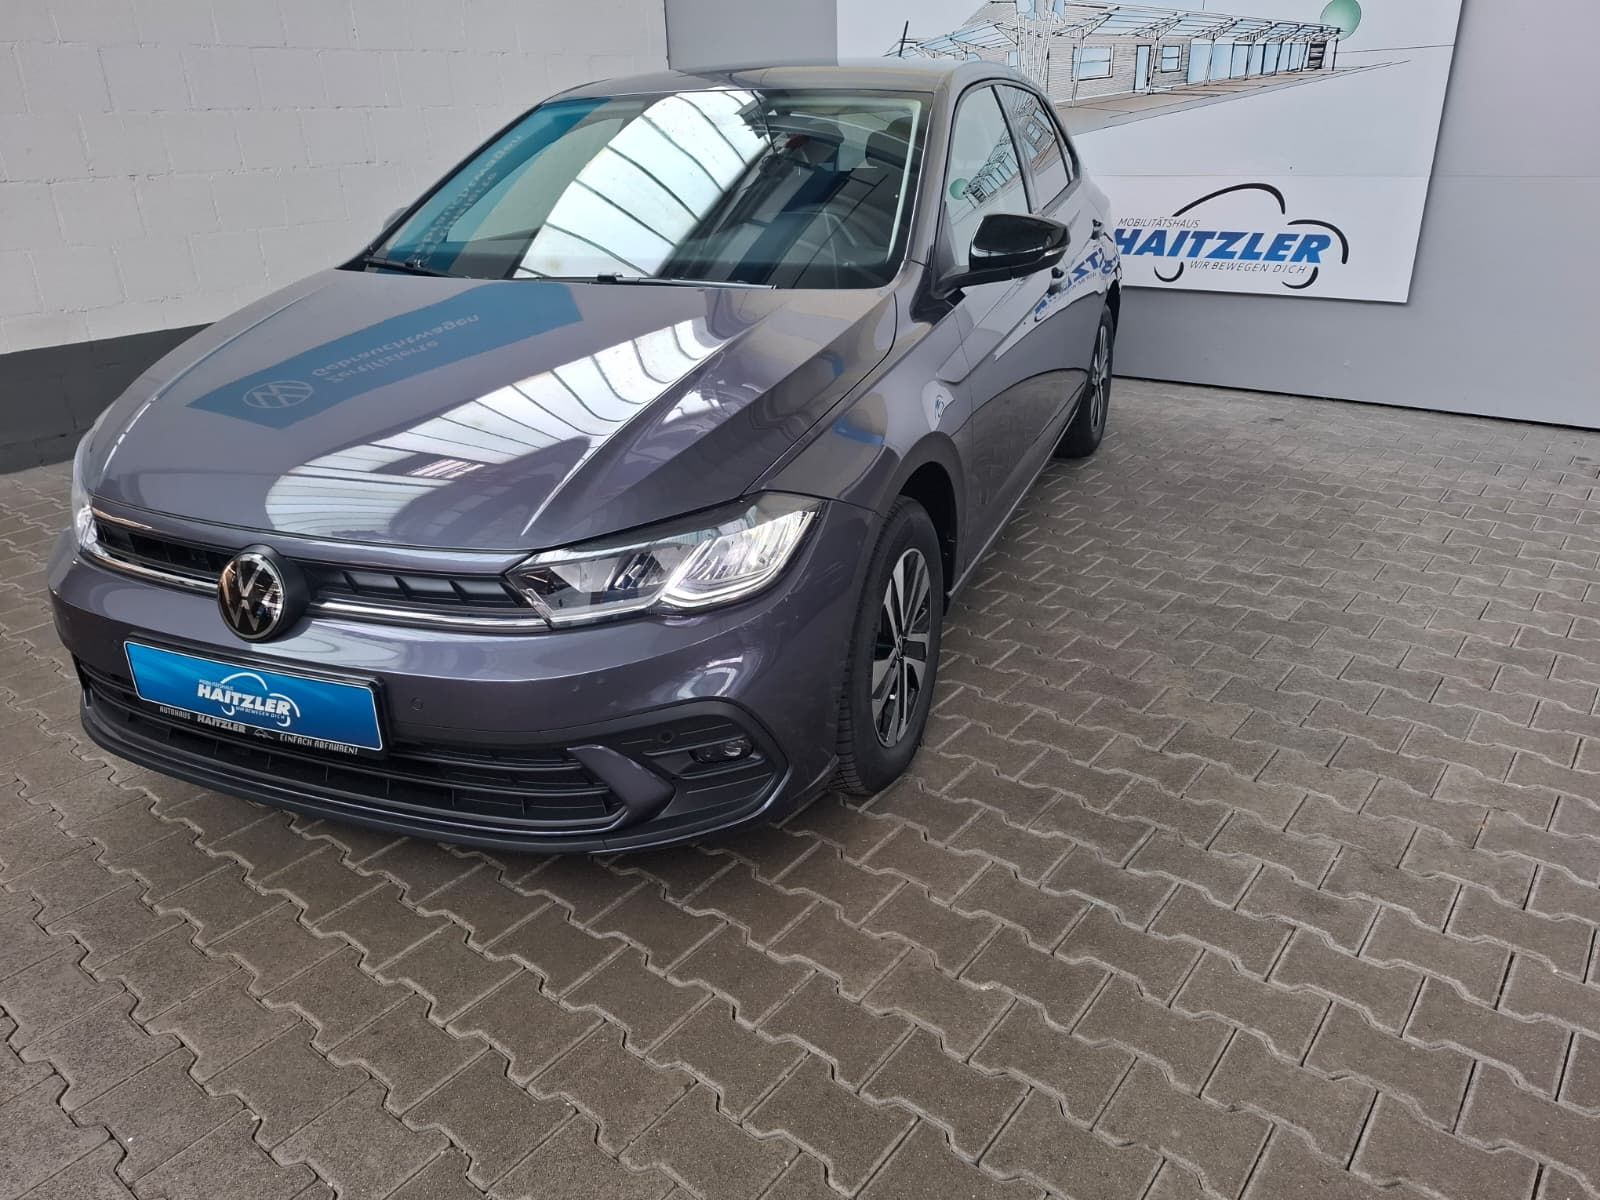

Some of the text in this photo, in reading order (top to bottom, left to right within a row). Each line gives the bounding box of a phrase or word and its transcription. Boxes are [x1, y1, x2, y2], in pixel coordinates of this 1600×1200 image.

[1114, 228, 1331, 264] HAITZLER
[1190, 261, 1306, 274] WIR BEWEGEN DICH
[197, 683, 291, 715] HAITZLER
[159, 705, 191, 720] AUTOHAUS
[197, 715, 247, 734] HAITZLER
[279, 733, 313, 747] EINFACH
